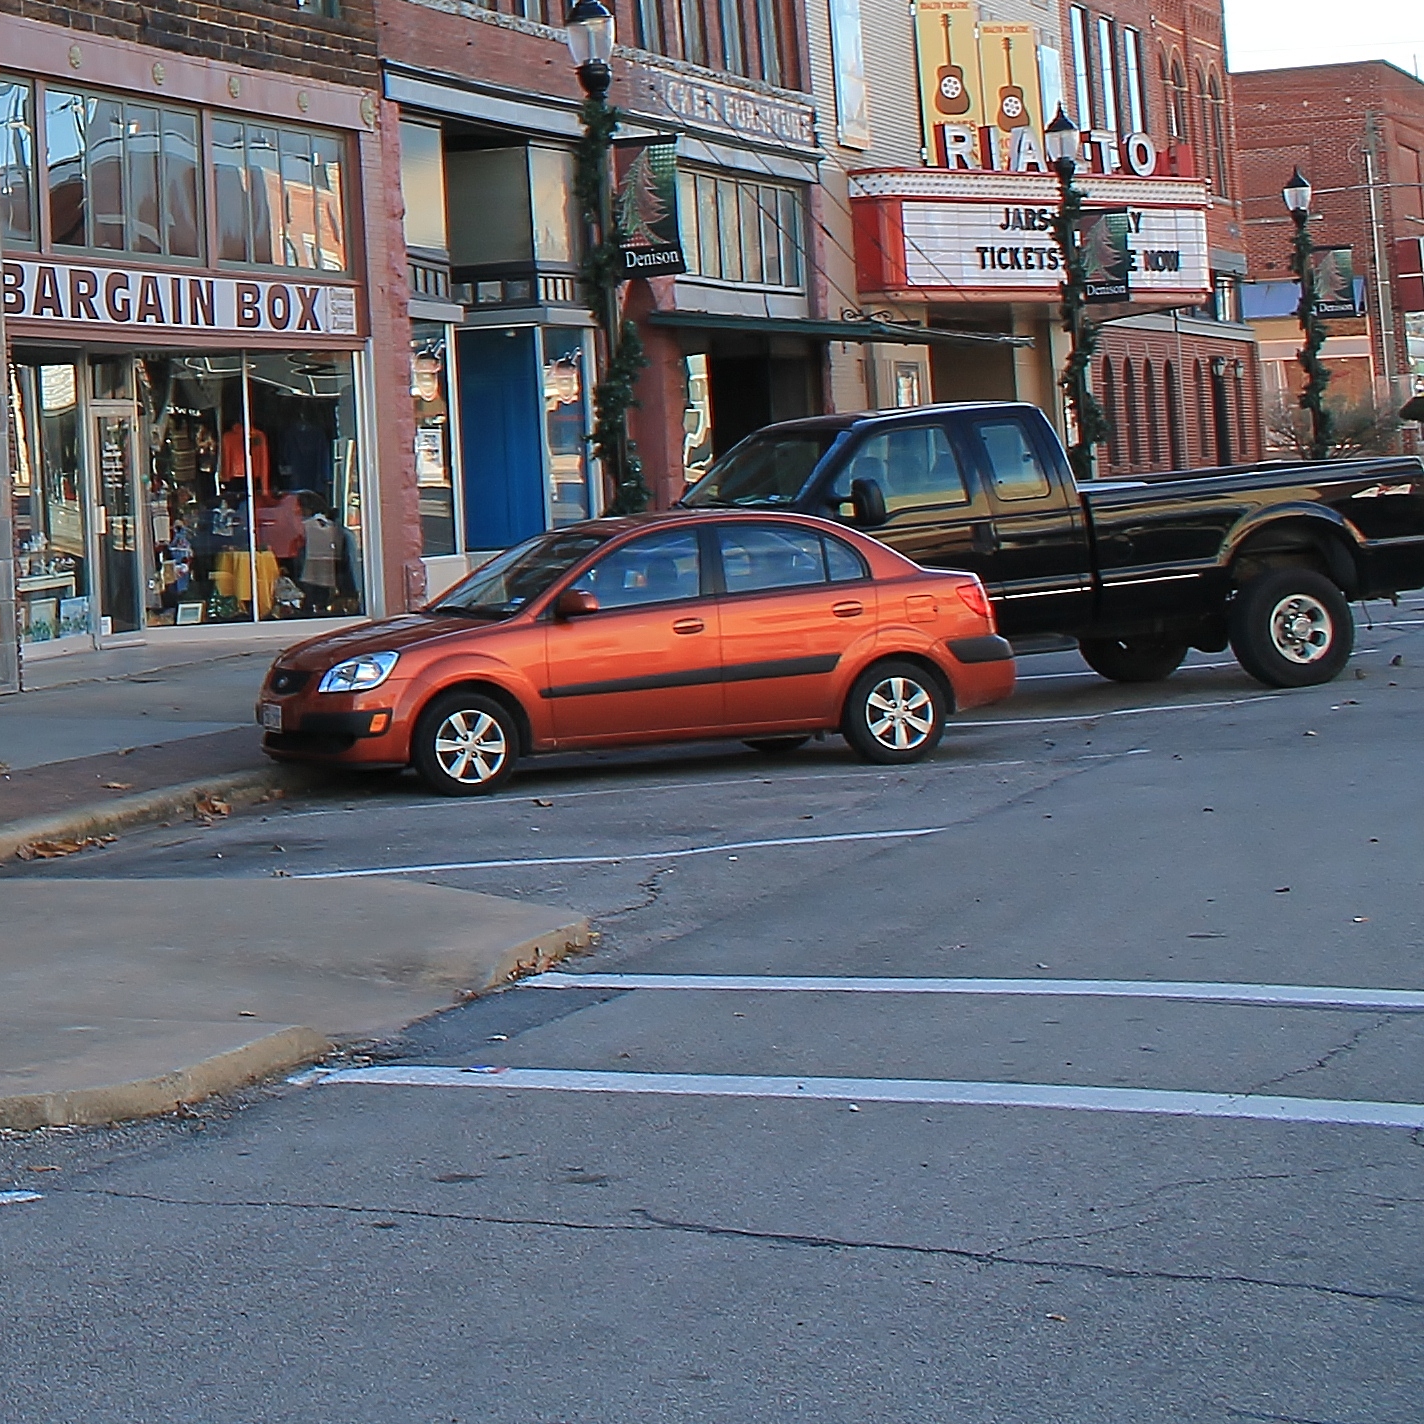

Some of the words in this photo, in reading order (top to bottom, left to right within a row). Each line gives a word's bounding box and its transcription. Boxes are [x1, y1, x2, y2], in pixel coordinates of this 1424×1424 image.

[936, 126, 1157, 176] RIATO
[1000, 207, 1050, 232] JARS
[625, 248, 680, 268] Denison
[976, 246, 1059, 271] TICKETS
[1143, 250, 1180, 272] NOW
[2, 263, 216, 326] BARGAIN
[235, 282, 322, 332] BOX
[1086, 282, 1126, 296] Denison
